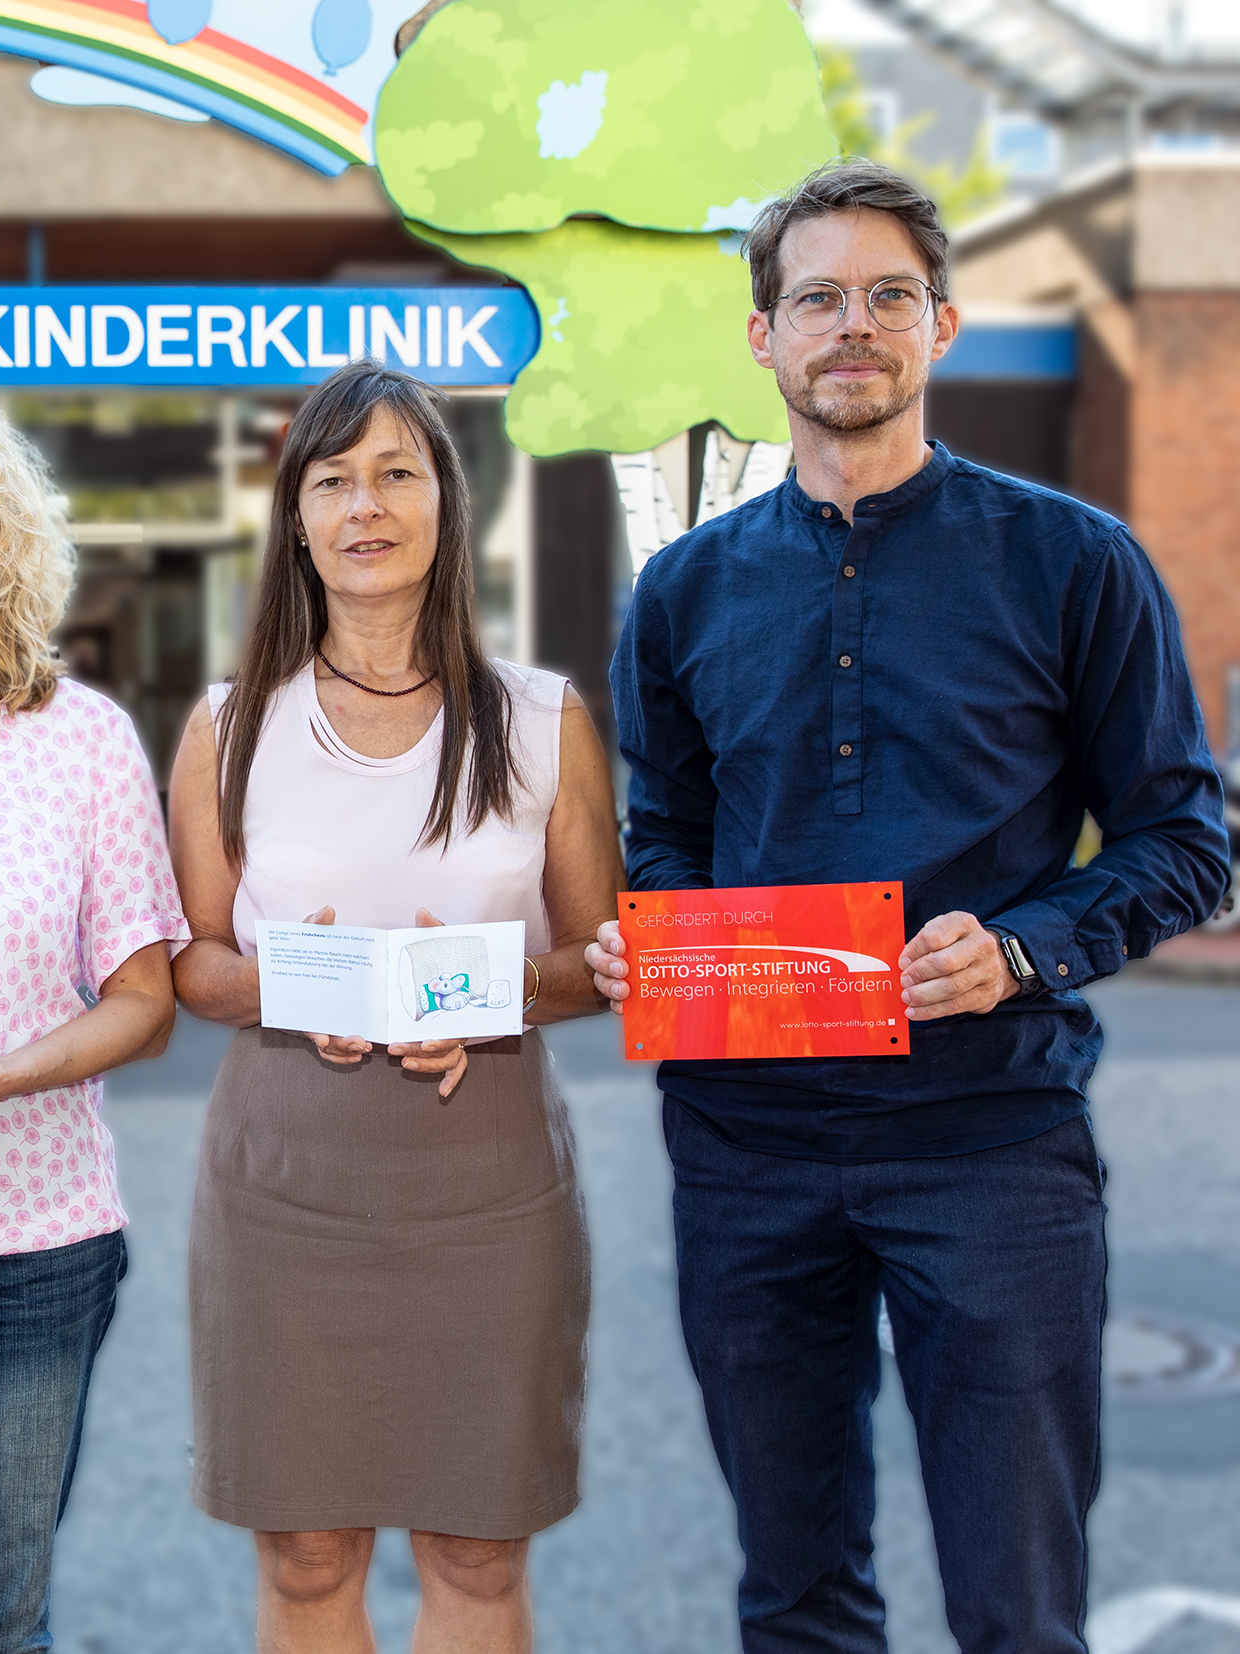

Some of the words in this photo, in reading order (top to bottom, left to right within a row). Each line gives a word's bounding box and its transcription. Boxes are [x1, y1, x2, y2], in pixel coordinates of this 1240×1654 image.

[636, 912, 718, 928] GEFÖRDERT
[723, 910, 774, 925] DURCH
[638, 953, 716, 964] Niedersächsische
[639, 960, 831, 979] LOTTO-SPORT-STIFTUNG
[640, 983, 714, 1000] Bewegen
[727, 980, 816, 998] Integrieren
[828, 976, 892, 994] Fördern
[779, 1018, 886, 1030] www.lotto-sport-stiftung.de
